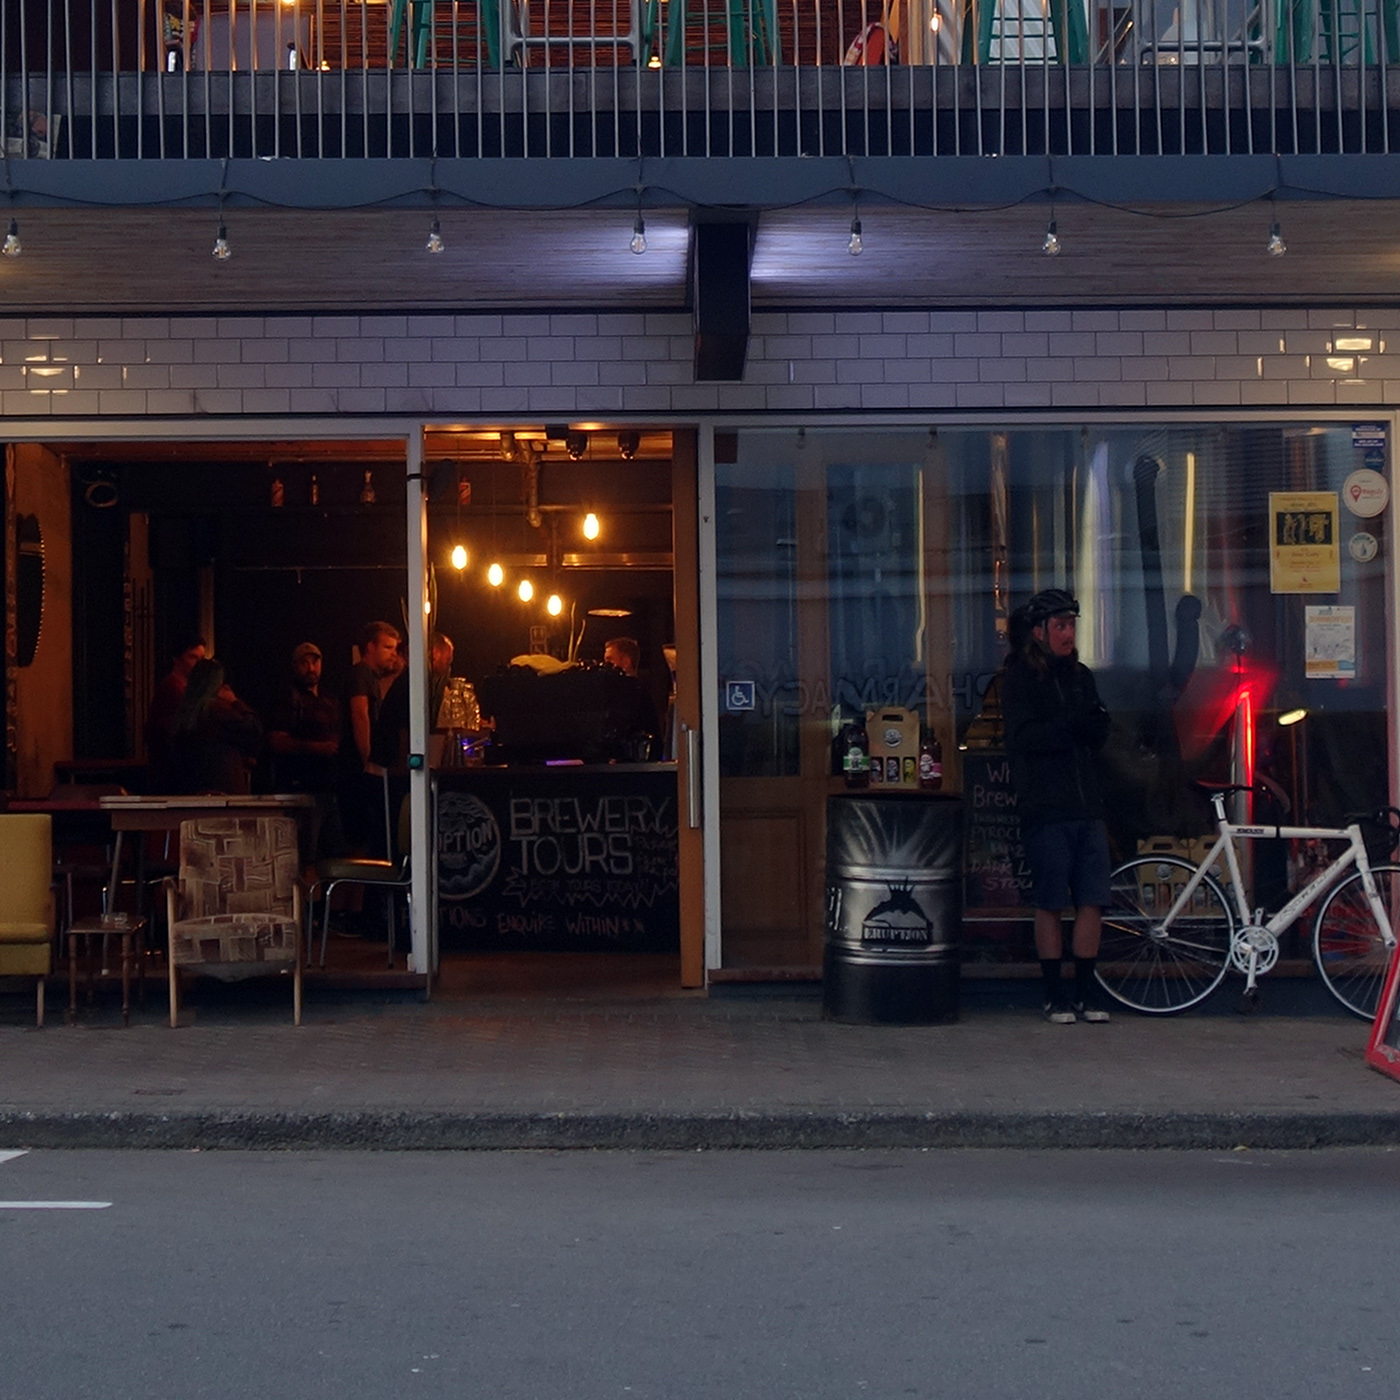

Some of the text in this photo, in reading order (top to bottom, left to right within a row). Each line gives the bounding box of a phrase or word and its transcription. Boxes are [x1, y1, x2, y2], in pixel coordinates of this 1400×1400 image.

[509, 798, 670, 834] BREWERY
[509, 833, 634, 876] TOURS
[863, 926, 929, 941] ERUPTION
